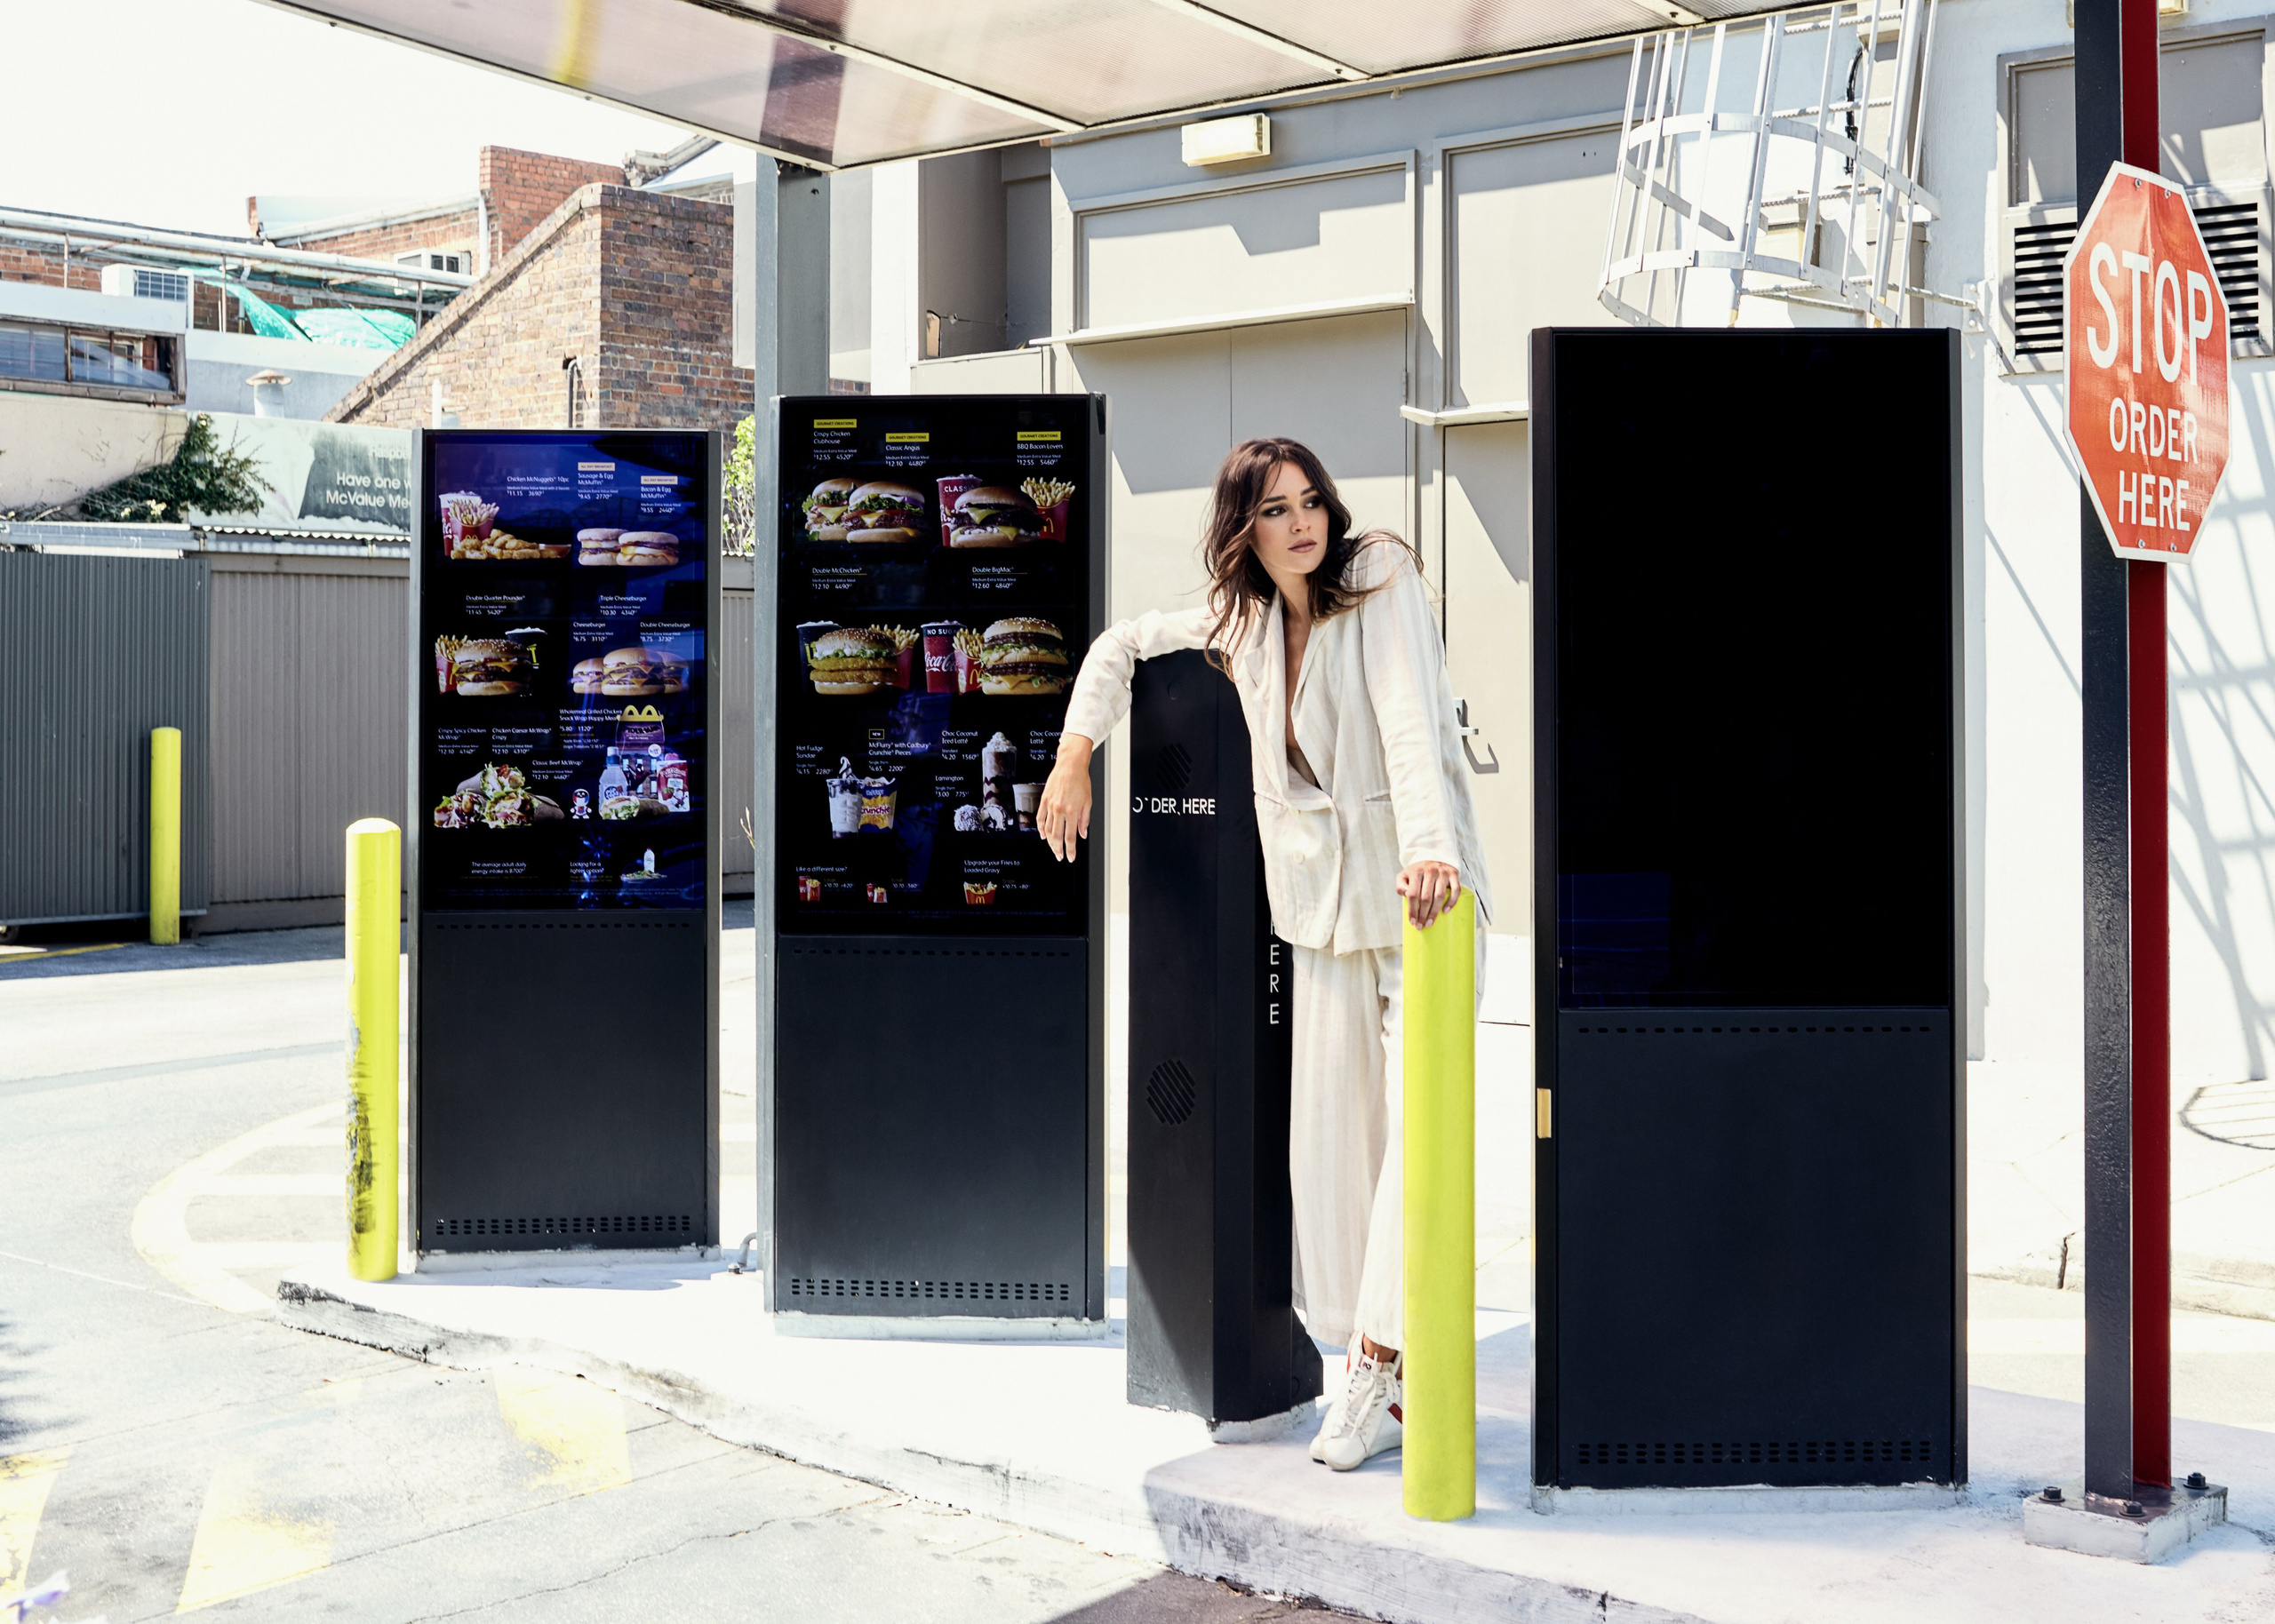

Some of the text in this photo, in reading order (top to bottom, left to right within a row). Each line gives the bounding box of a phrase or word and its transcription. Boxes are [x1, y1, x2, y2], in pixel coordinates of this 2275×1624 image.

[2086, 241, 2213, 386] STOP
[2109, 397, 2198, 464] ORDER
[325, 489, 412, 509] McValue Me
[336, 471, 372, 488] Have
[374, 476, 401, 490] one
[2118, 470, 2191, 532] HERE
[1182, 796, 1216, 816] HERE
[1269, 918, 1280, 1025] ERE
